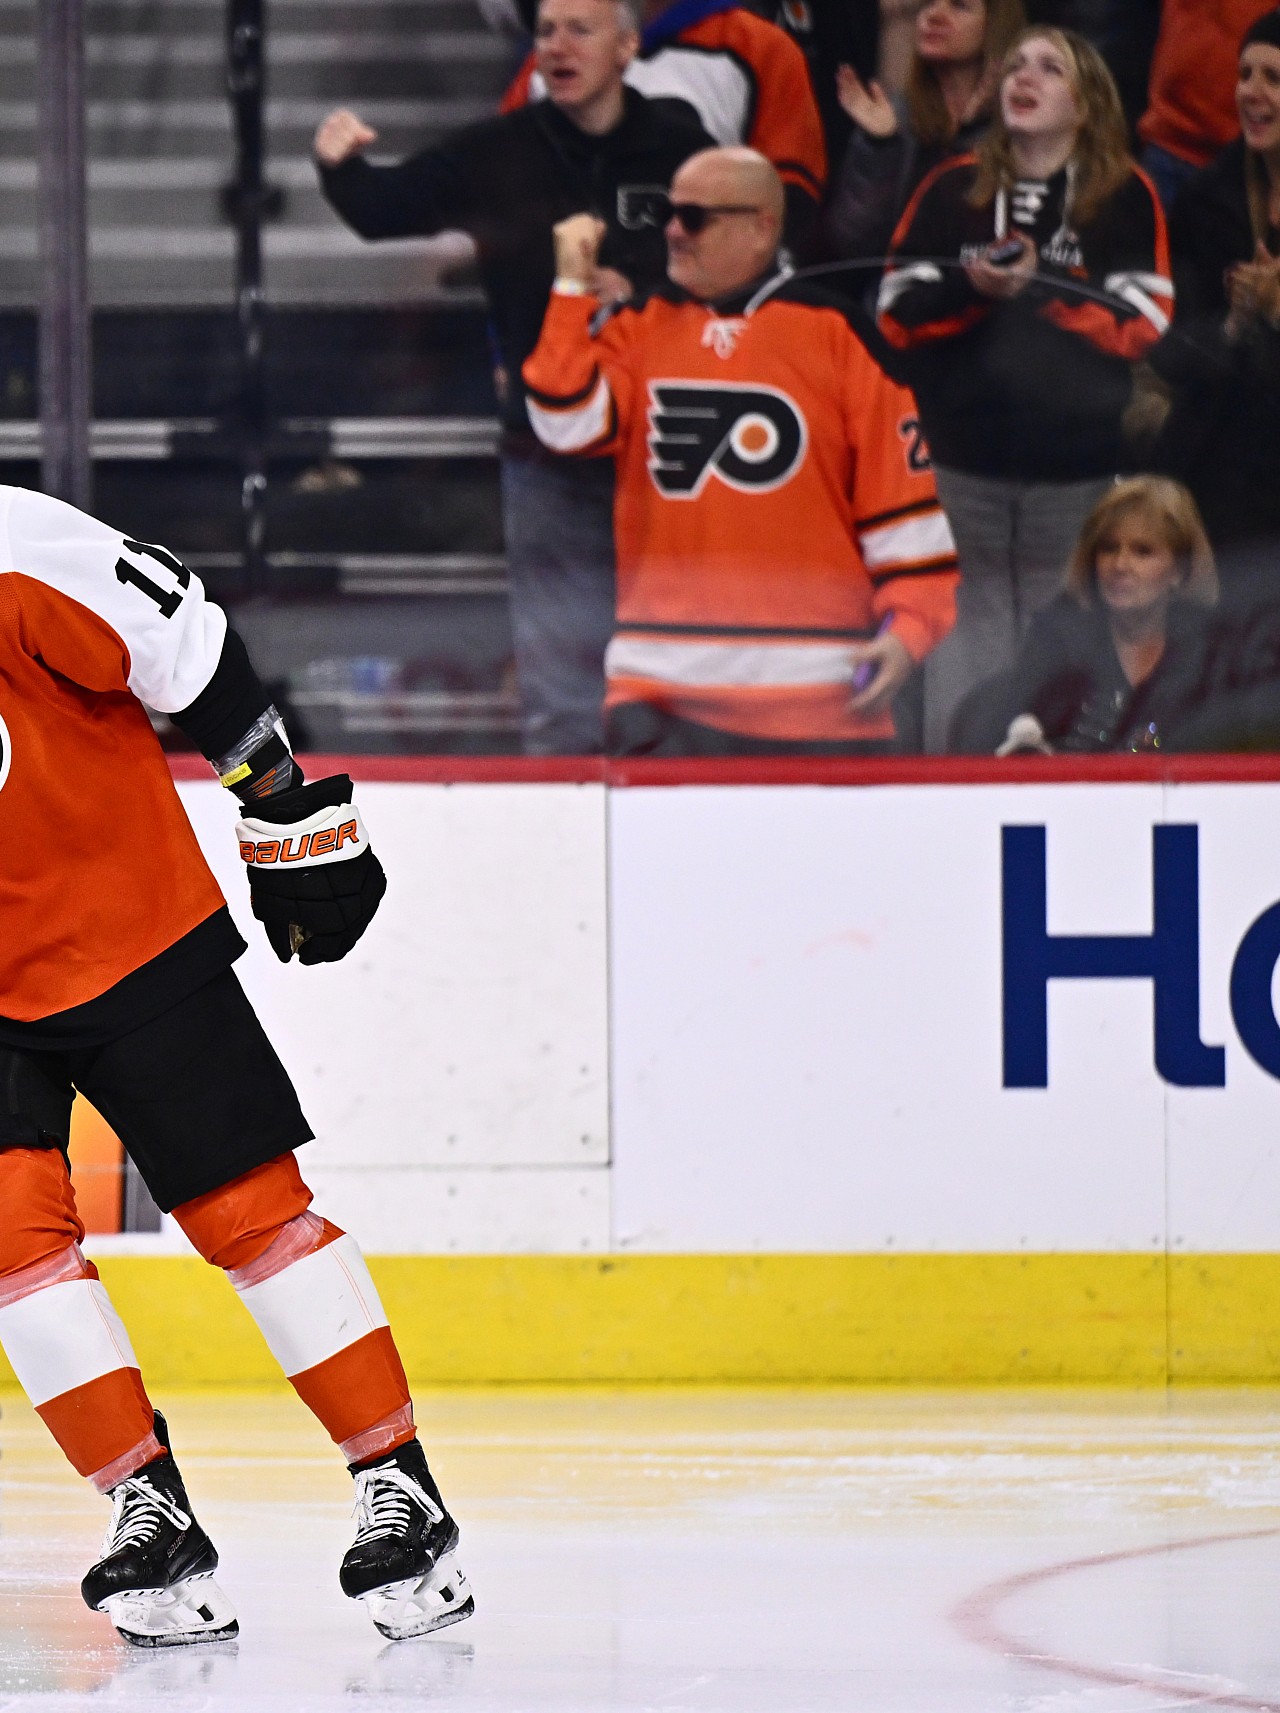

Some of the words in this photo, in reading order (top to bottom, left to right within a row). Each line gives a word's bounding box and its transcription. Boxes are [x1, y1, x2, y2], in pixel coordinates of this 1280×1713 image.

[115, 539, 190, 619] 11
[239, 819, 359, 863] BAUER
[1001, 823, 1280, 1090] H
